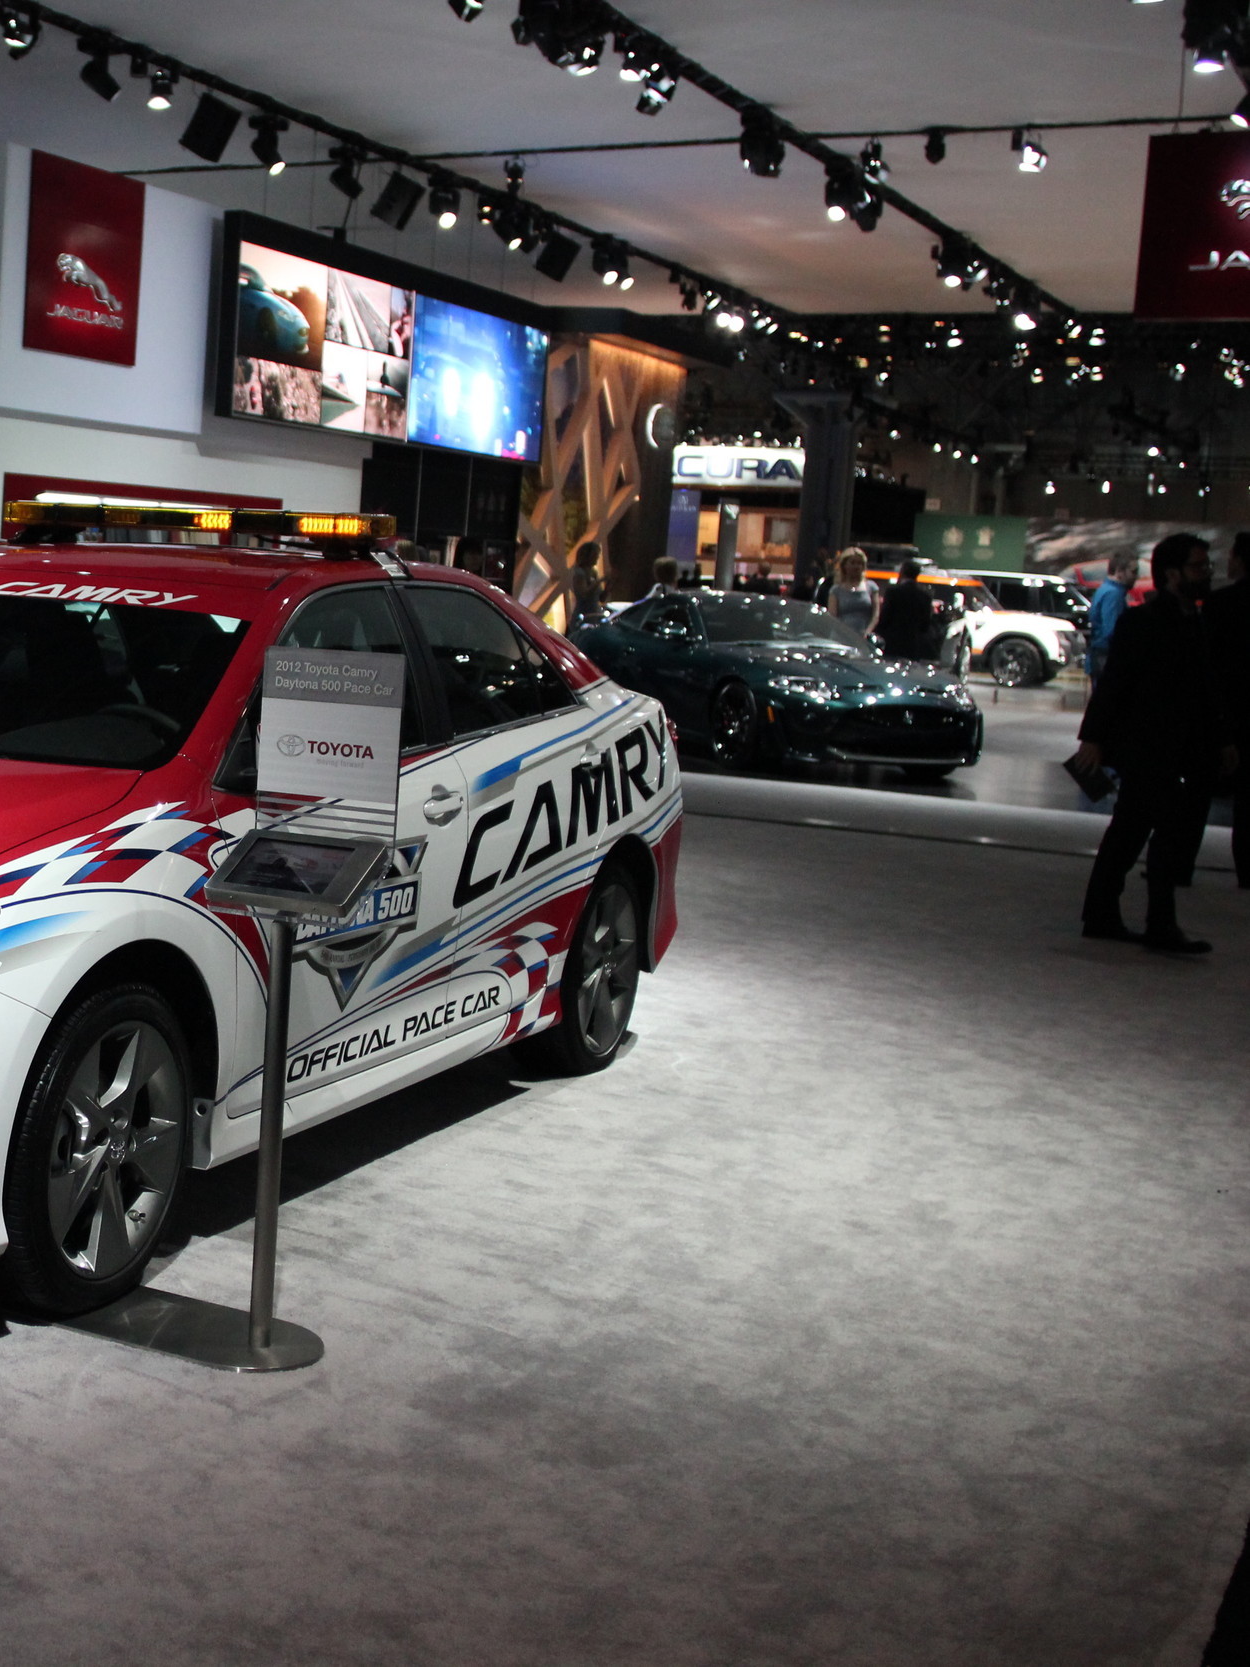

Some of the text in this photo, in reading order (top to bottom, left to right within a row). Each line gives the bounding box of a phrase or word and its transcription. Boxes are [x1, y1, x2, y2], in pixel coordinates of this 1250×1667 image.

[46, 303, 124, 330] JAGUAR
[276, 660, 378, 681] 2012 Toyota Camry
[275, 676, 395, 696] Daytona 500 Pace Car
[308, 740, 374, 759] TOYOTA
[453, 708, 666, 909] CAMRY
[377, 886, 415, 920] 500
[286, 986, 500, 1083] OFFICIAL PACE CAR
